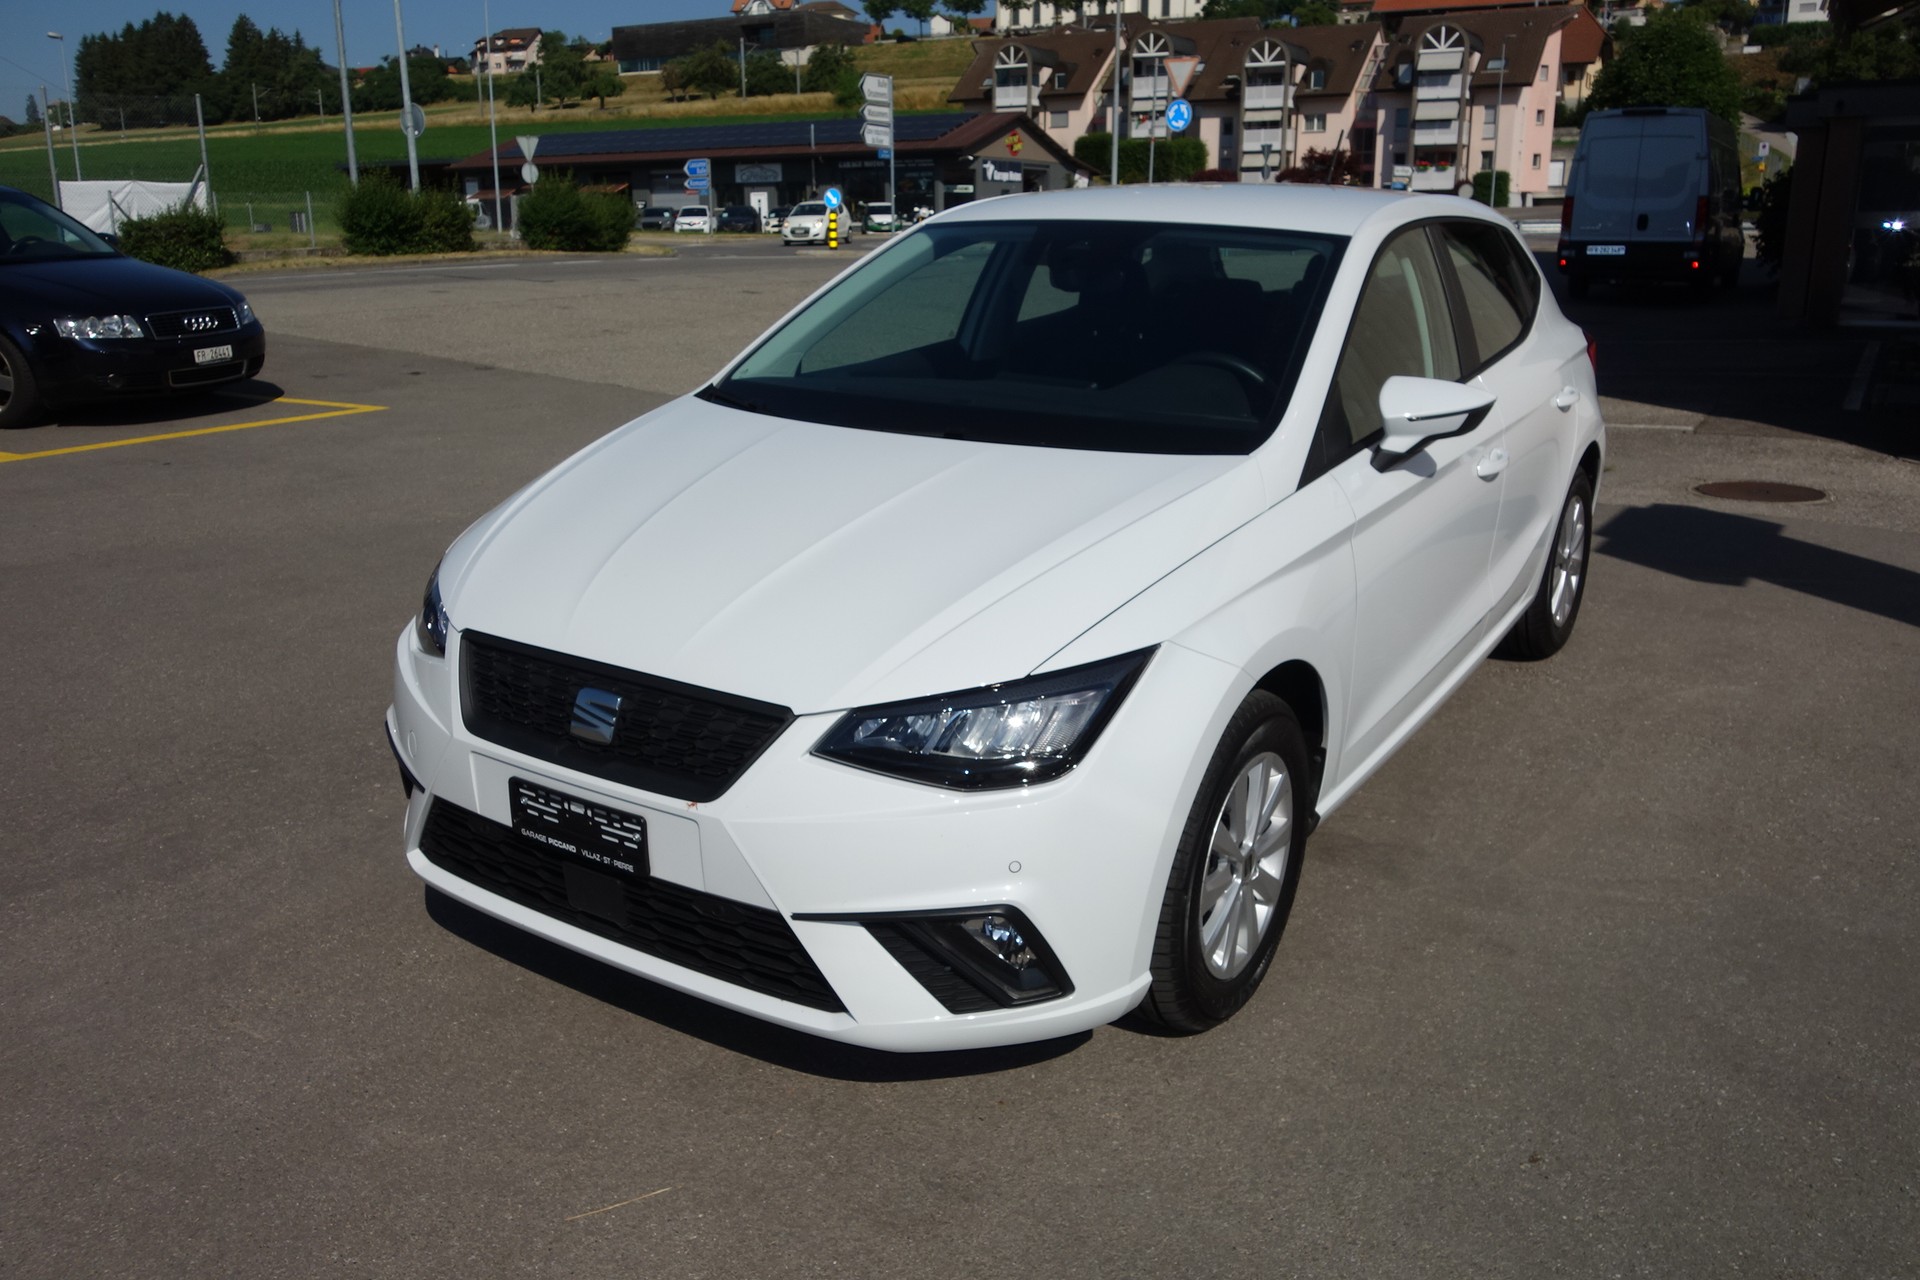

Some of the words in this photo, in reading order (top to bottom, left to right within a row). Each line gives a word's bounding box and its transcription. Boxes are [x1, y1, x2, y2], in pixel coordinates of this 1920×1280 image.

[197, 350, 206, 361] FR
[521, 828, 547, 843] GARAGE
[548, 837, 576, 853] PICCAND
